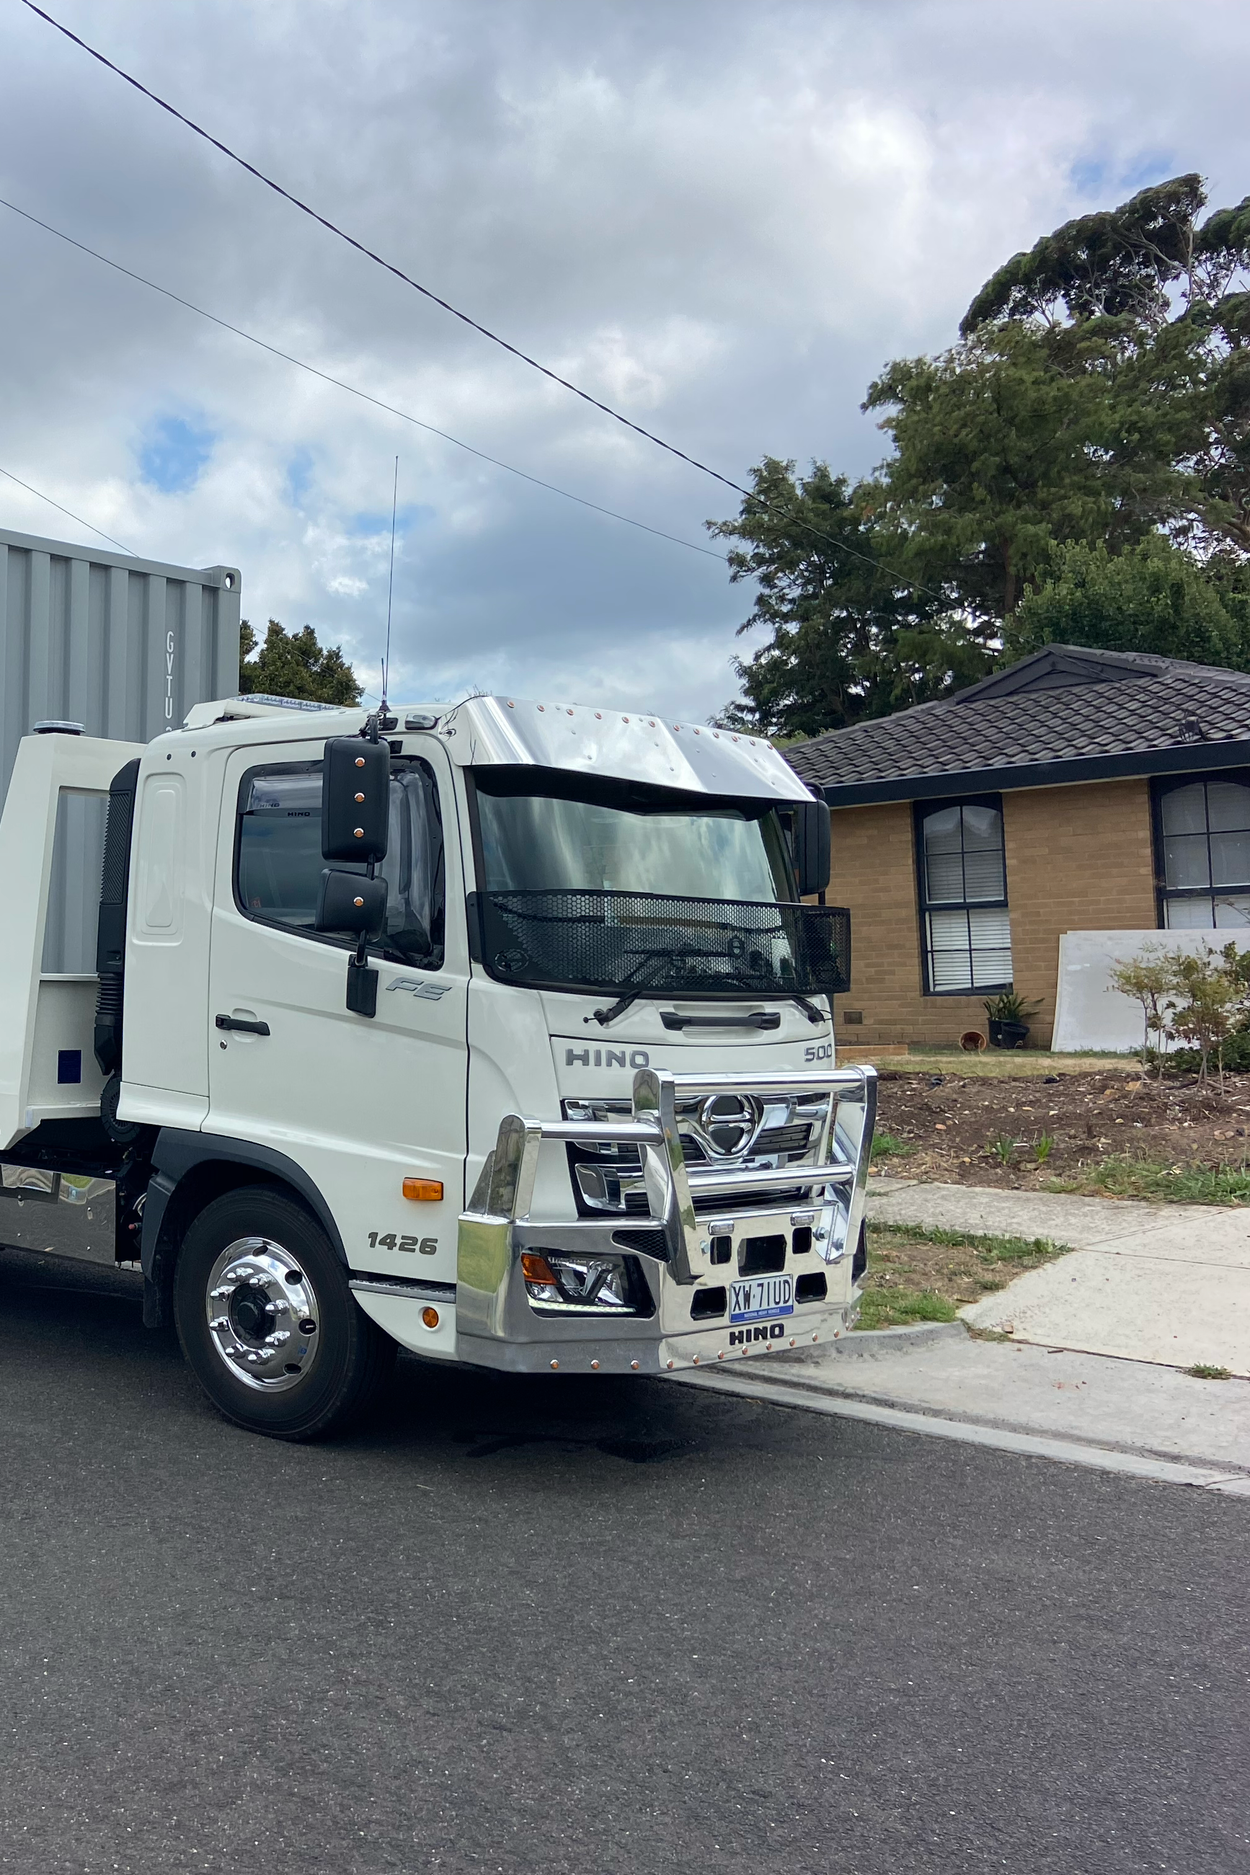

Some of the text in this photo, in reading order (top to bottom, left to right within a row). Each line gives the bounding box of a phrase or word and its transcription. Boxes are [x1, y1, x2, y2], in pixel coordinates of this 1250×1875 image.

[165, 630, 174, 719] GVTU
[385, 976, 453, 1001] FE
[564, 1048, 650, 1069] HINO
[804, 1043, 832, 1063] 500
[367, 1231, 439, 1255] 1426
[729, 1322, 785, 1346] HINO
